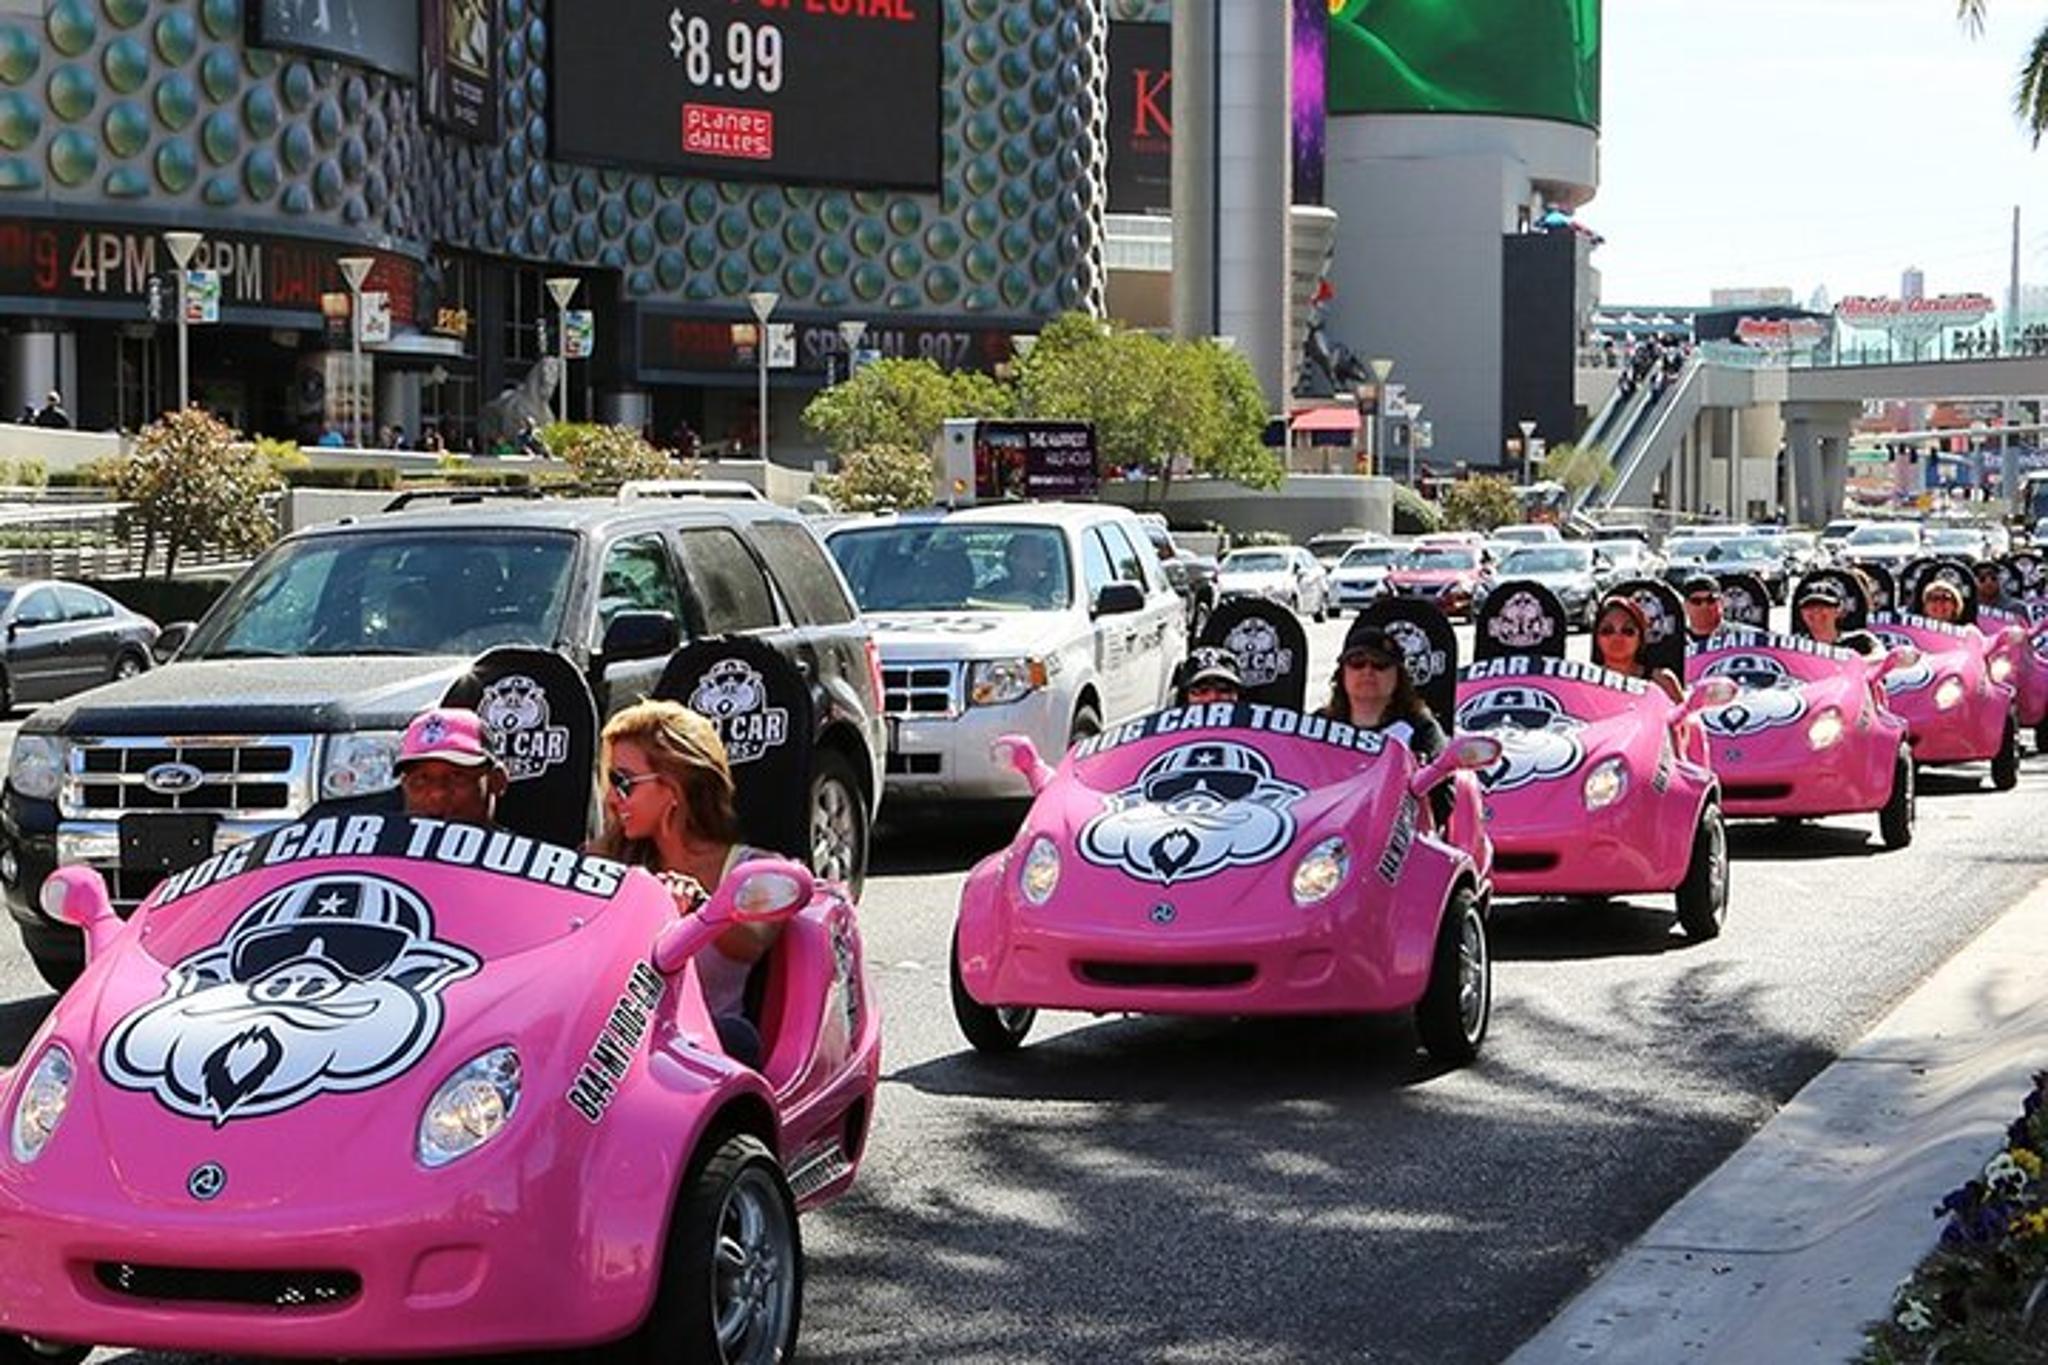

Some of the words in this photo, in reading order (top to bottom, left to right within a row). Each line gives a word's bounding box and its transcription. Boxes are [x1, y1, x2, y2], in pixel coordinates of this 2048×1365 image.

[669, 8, 783, 92] $8.99
[70, 232, 156, 293] 4PM
[804, 327, 906, 359] SPIAL
[1467, 655, 1530, 681] CAR
[1541, 656, 1647, 696] TOURS
[513, 731, 562, 758] CAR
[729, 713, 781, 740] CAR
[1075, 718, 1146, 759] HOG
[1156, 702, 1235, 733] CAR
[1250, 703, 1383, 753] TOURS
[151, 841, 256, 905] HOG
[263, 813, 385, 867] CAR
[406, 816, 627, 897] TOURS
